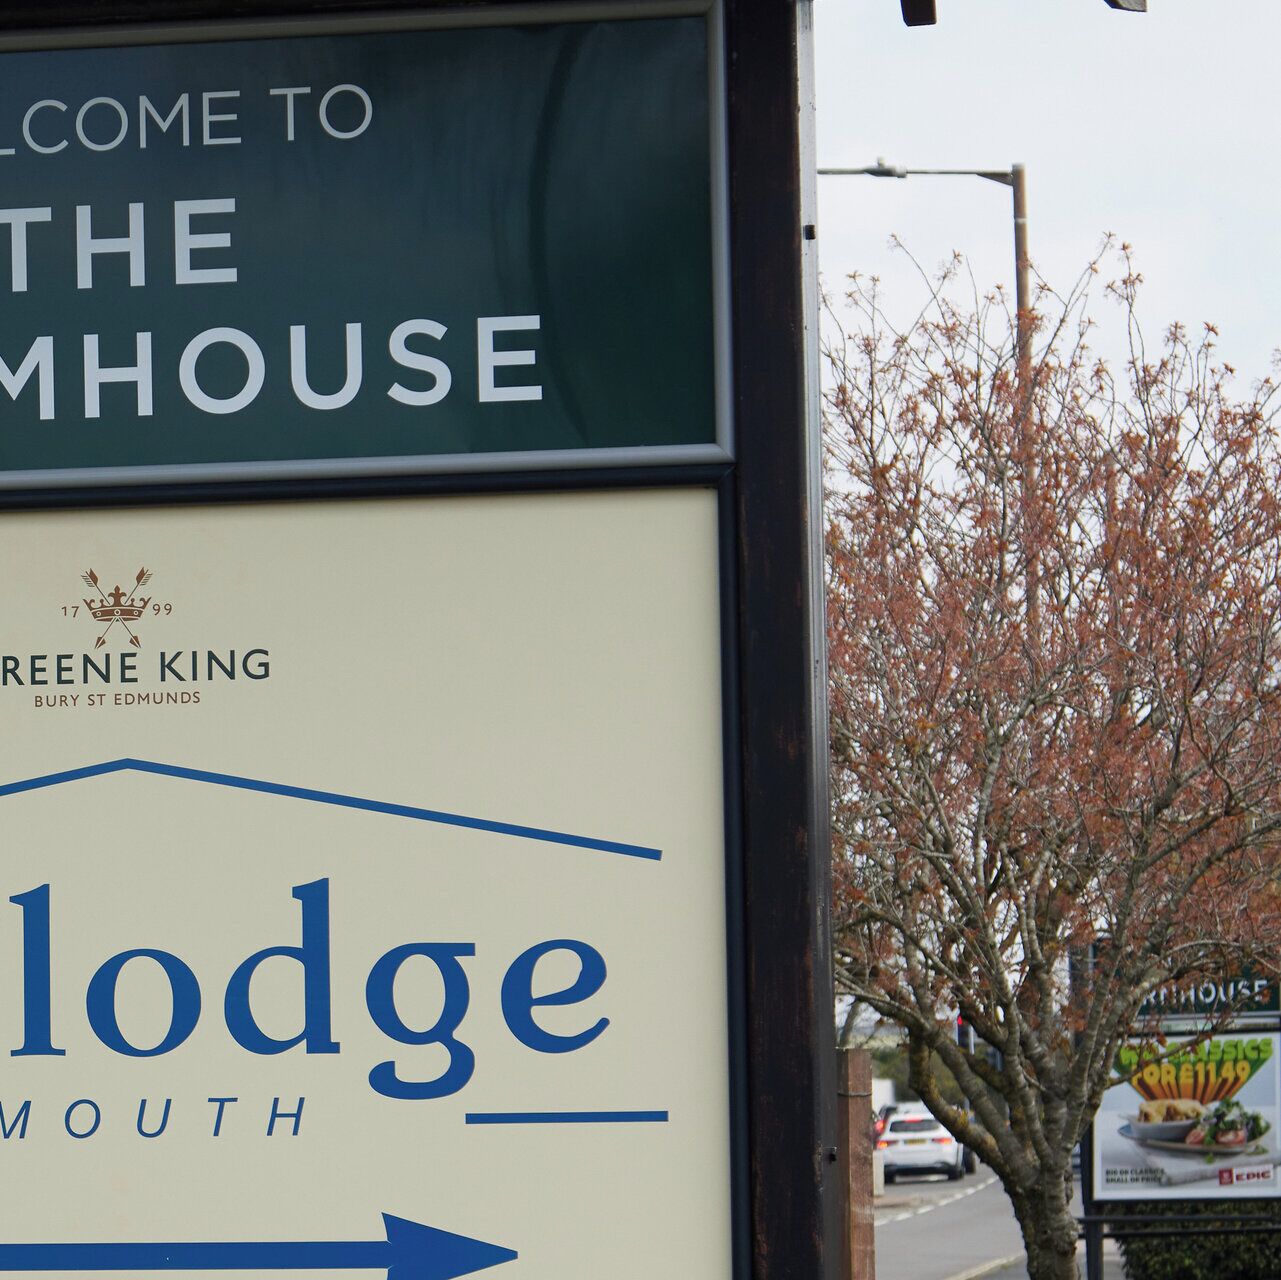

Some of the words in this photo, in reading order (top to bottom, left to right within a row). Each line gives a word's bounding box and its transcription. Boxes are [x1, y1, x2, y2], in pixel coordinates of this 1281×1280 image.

[269, 83, 373, 141] TO
[61, 605, 80, 618] 17
[152, 603, 173, 616] 99
[159, 648, 270, 683] KING
[34, 694, 80, 708] BURY
[87, 693, 107, 707] ST
[114, 691, 201, 706] EDMUNDS
